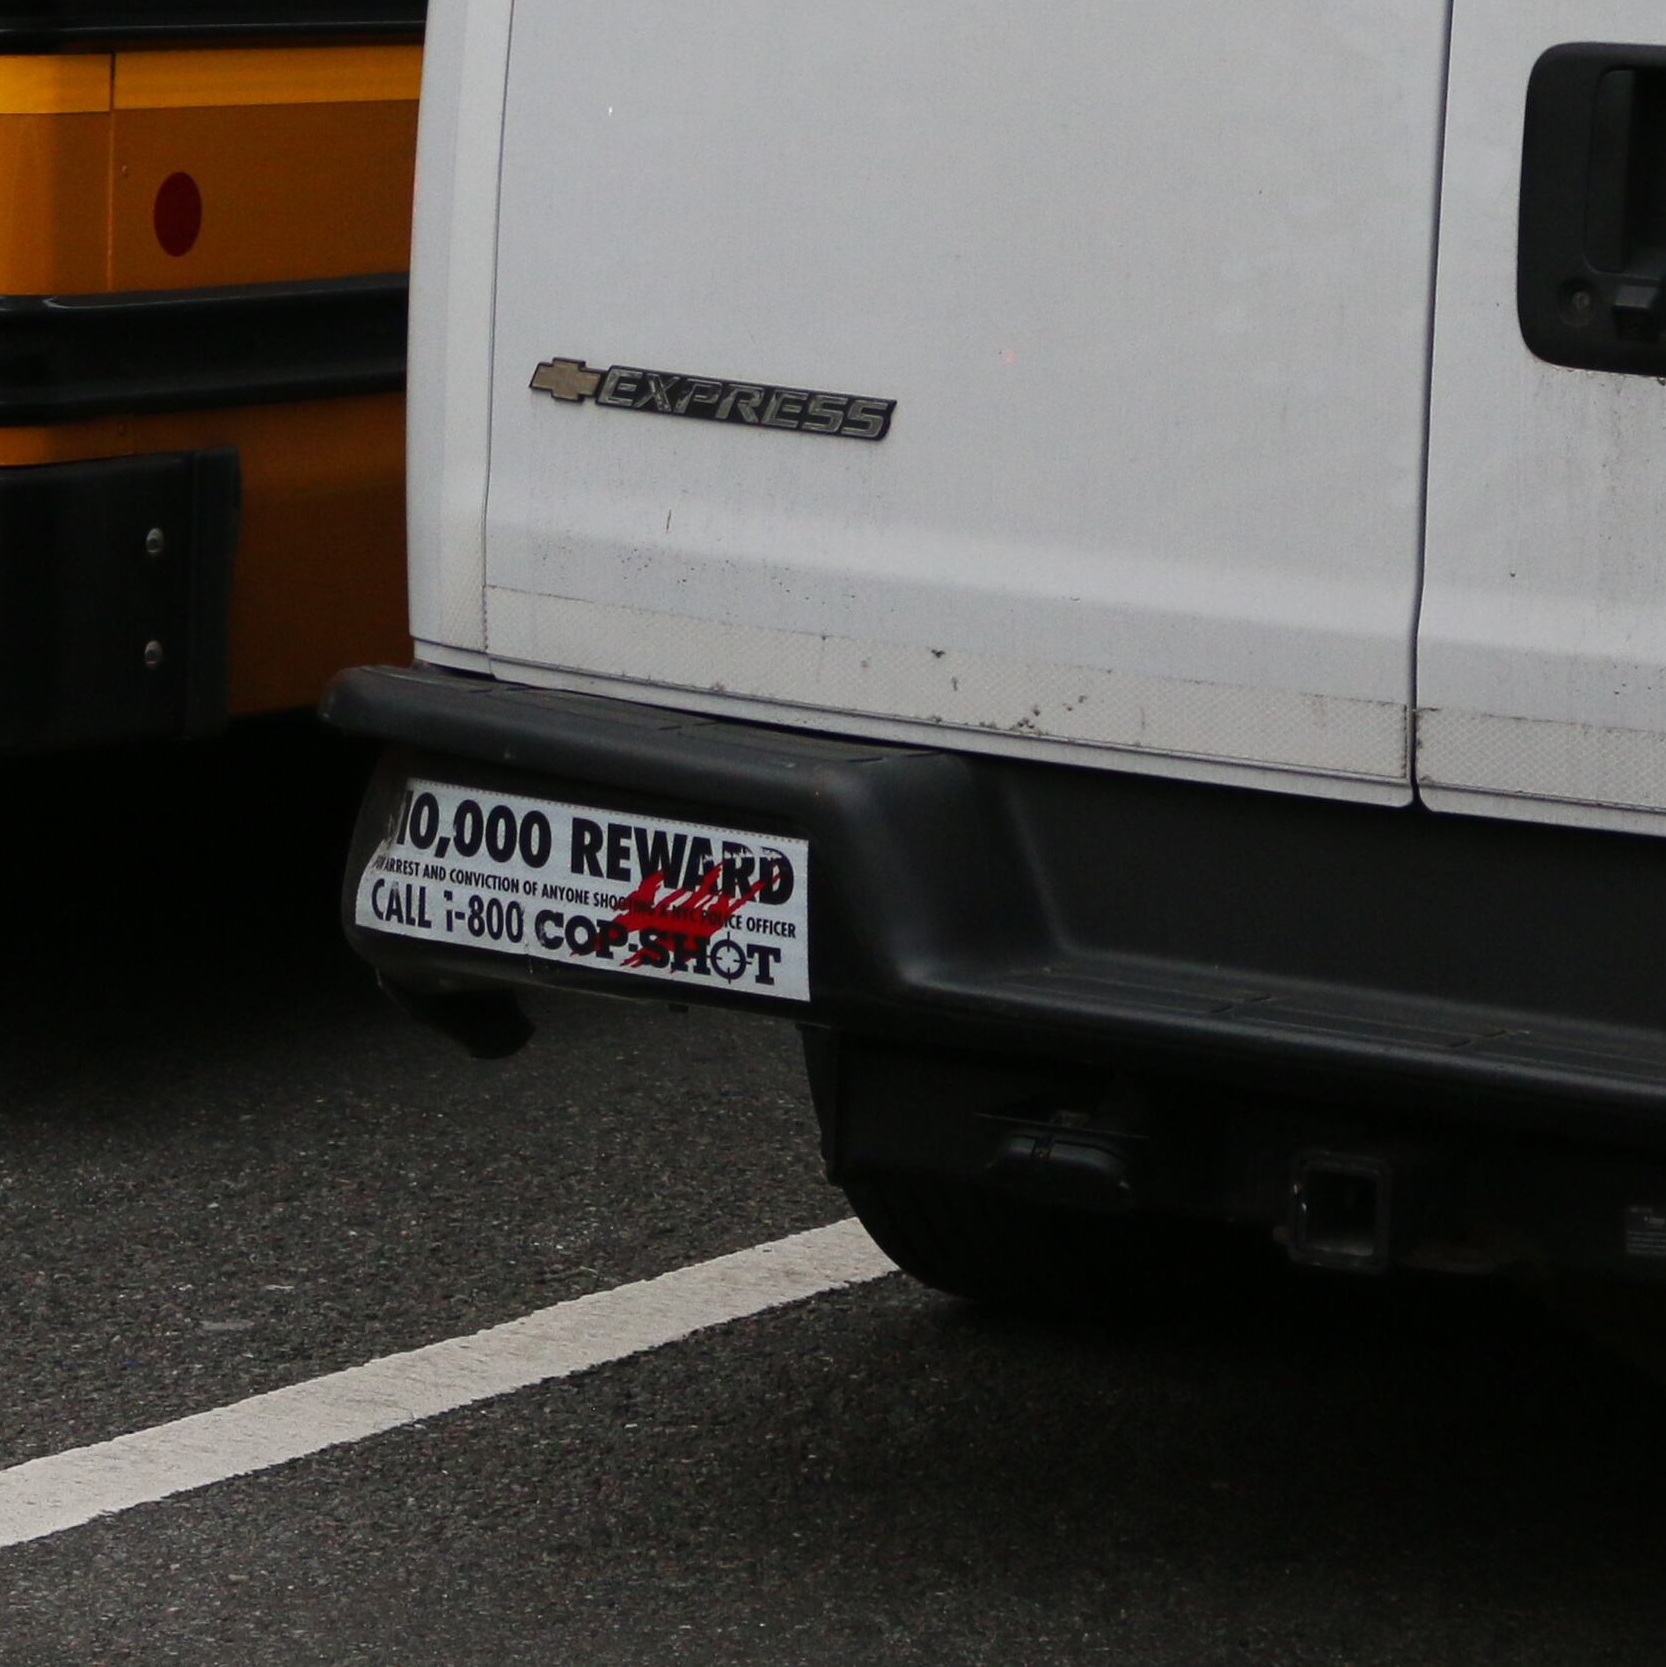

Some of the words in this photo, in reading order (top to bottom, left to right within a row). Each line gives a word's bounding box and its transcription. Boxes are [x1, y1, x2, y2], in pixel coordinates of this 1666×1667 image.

[599, 369, 889, 438] EXPRESS
[570, 817, 795, 905] REWARD
[371, 878, 432, 928] CALL
[422, 864, 446, 881] AND
[449, 868, 520, 894] CONVICTION
[523, 881, 539, 896] OF
[541, 883, 590, 905] ANYONE
[746, 916, 797, 939] OFFICER
